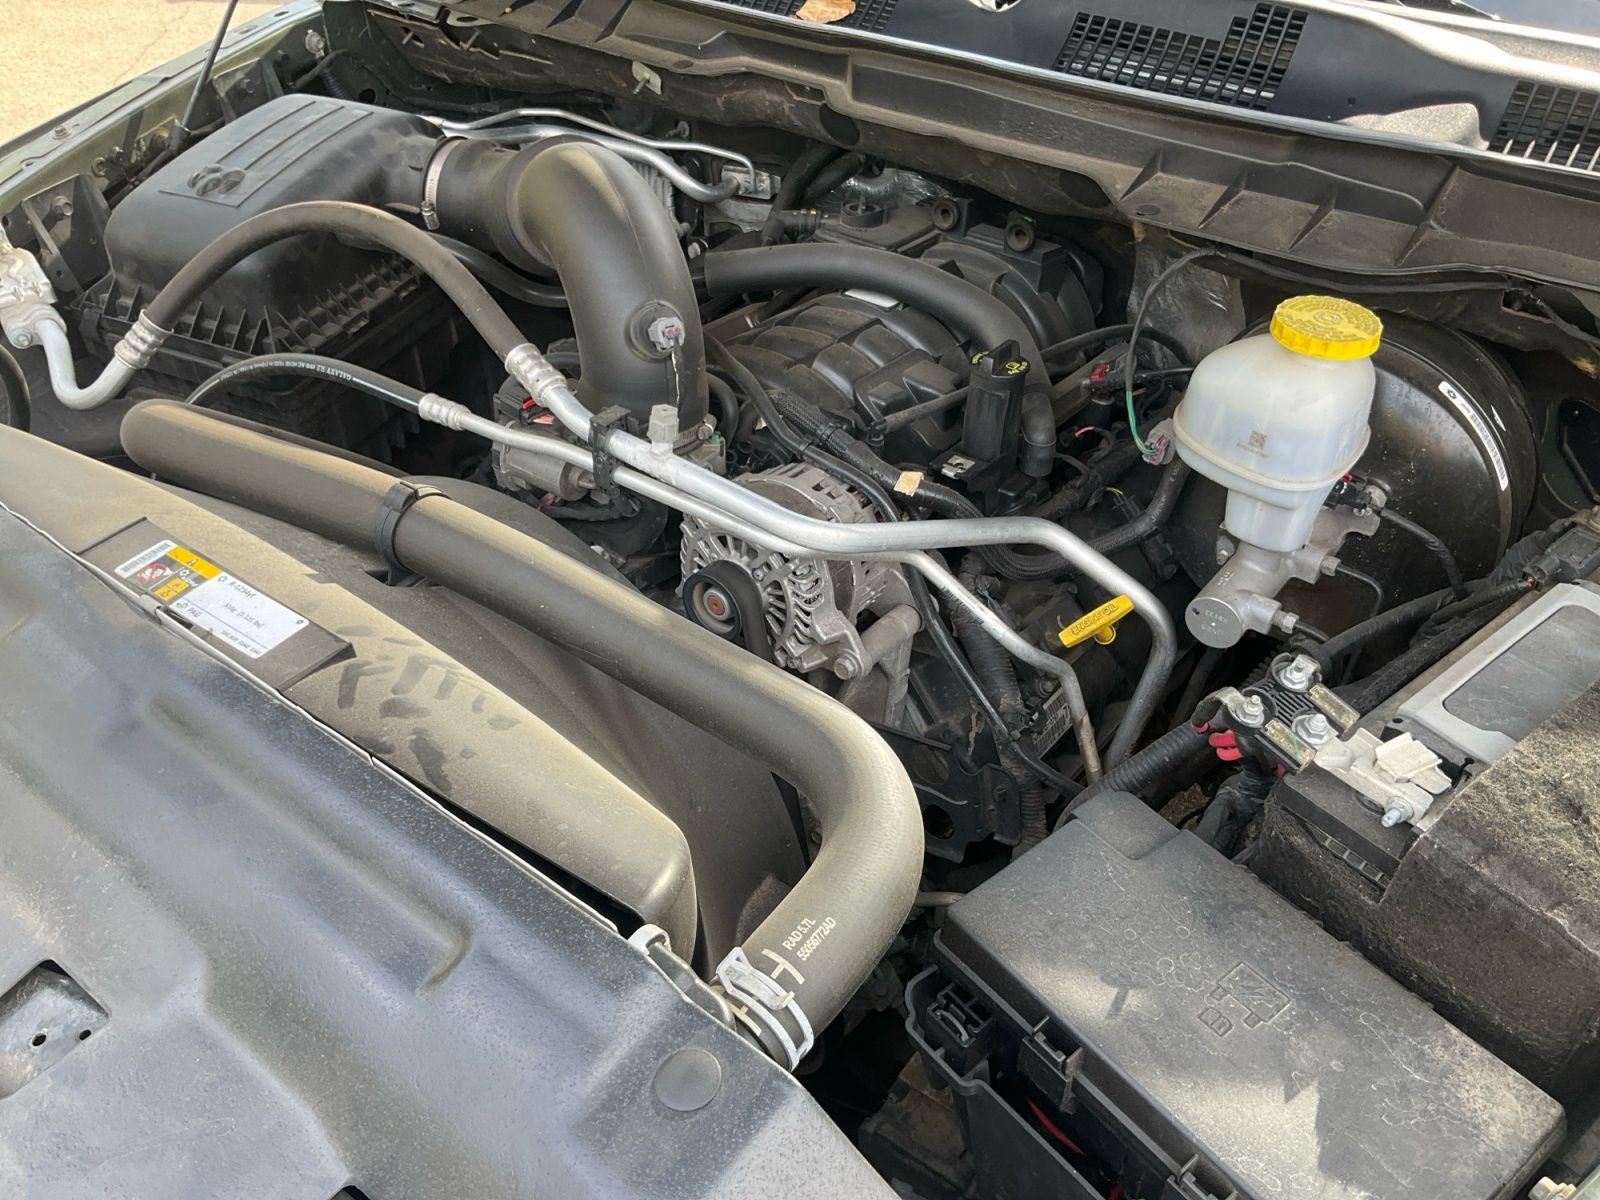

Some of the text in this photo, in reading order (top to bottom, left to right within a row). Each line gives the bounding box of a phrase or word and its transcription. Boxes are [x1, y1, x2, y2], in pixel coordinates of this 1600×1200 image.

[1070, 603, 1119, 635] ENGINE OIL
[782, 917, 817, 951] RAD 5.7L
